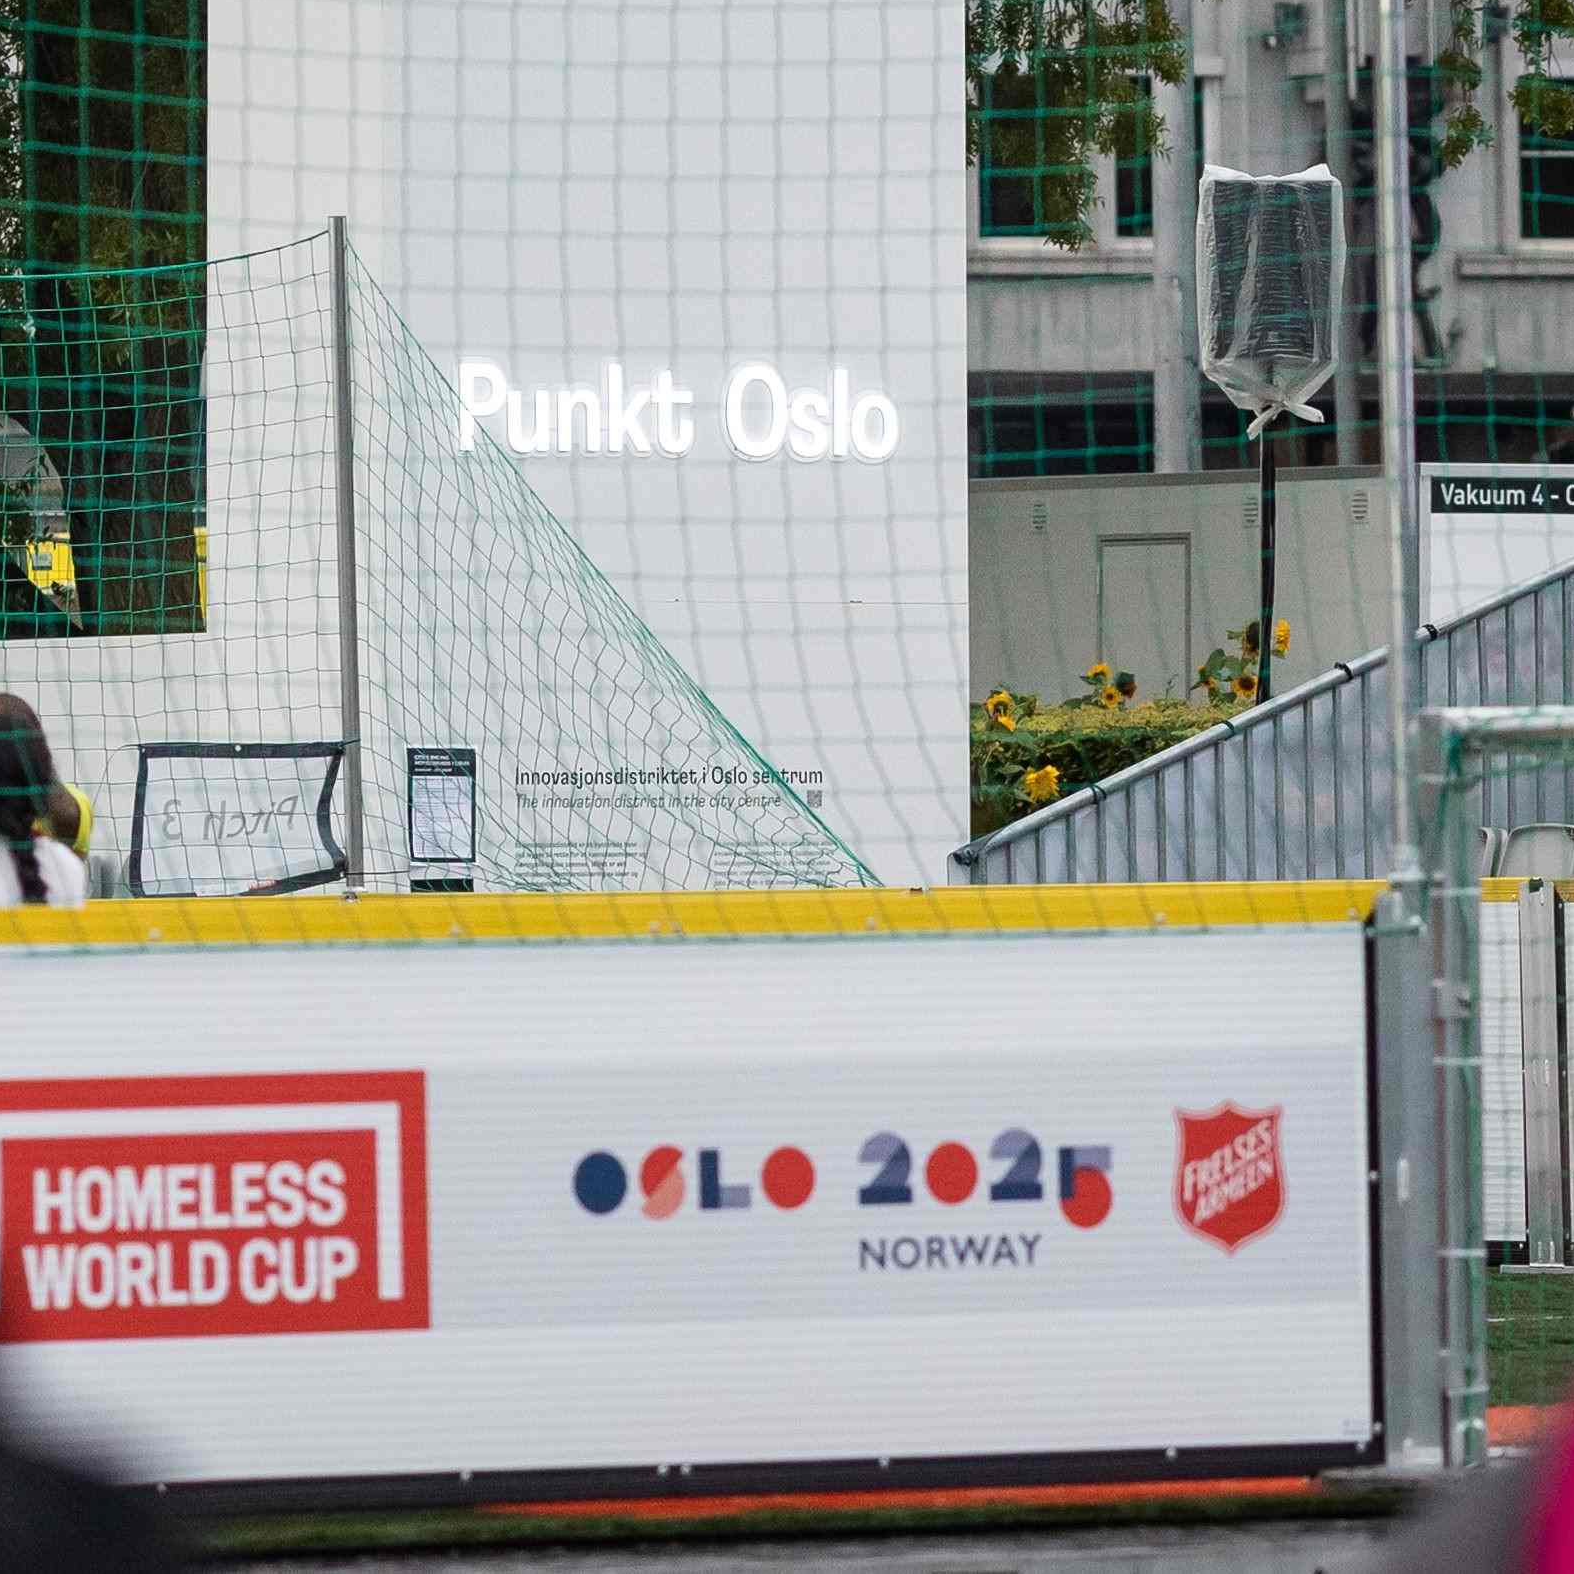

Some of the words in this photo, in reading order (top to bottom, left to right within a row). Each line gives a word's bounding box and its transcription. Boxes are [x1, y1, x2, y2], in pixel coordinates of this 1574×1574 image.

[458, 361, 694, 454] Punkt
[726, 361, 899, 462] Oslo
[1441, 483, 1526, 506] Vakuum
[1531, 484, 1545, 506] 4
[516, 767, 697, 789] Innovasjonsdistriktet
[712, 766, 747, 785] Oslo
[516, 793, 538, 808] The
[542, 793, 610, 808] innovation
[614, 793, 665, 808] district
[669, 794, 682, 808] in
[684, 794, 705, 808] the
[710, 794, 735, 811] city
[738, 795, 781, 808] centre
[31, 1158, 348, 1234] HOMELESS
[573, 1143, 816, 1222] OSLO
[857, 1127, 1113, 1231] 2025
[20, 1239, 230, 1311] WORLD
[237, 1235, 360, 1305] CUP
[857, 1233, 1042, 1270] NORWAY
